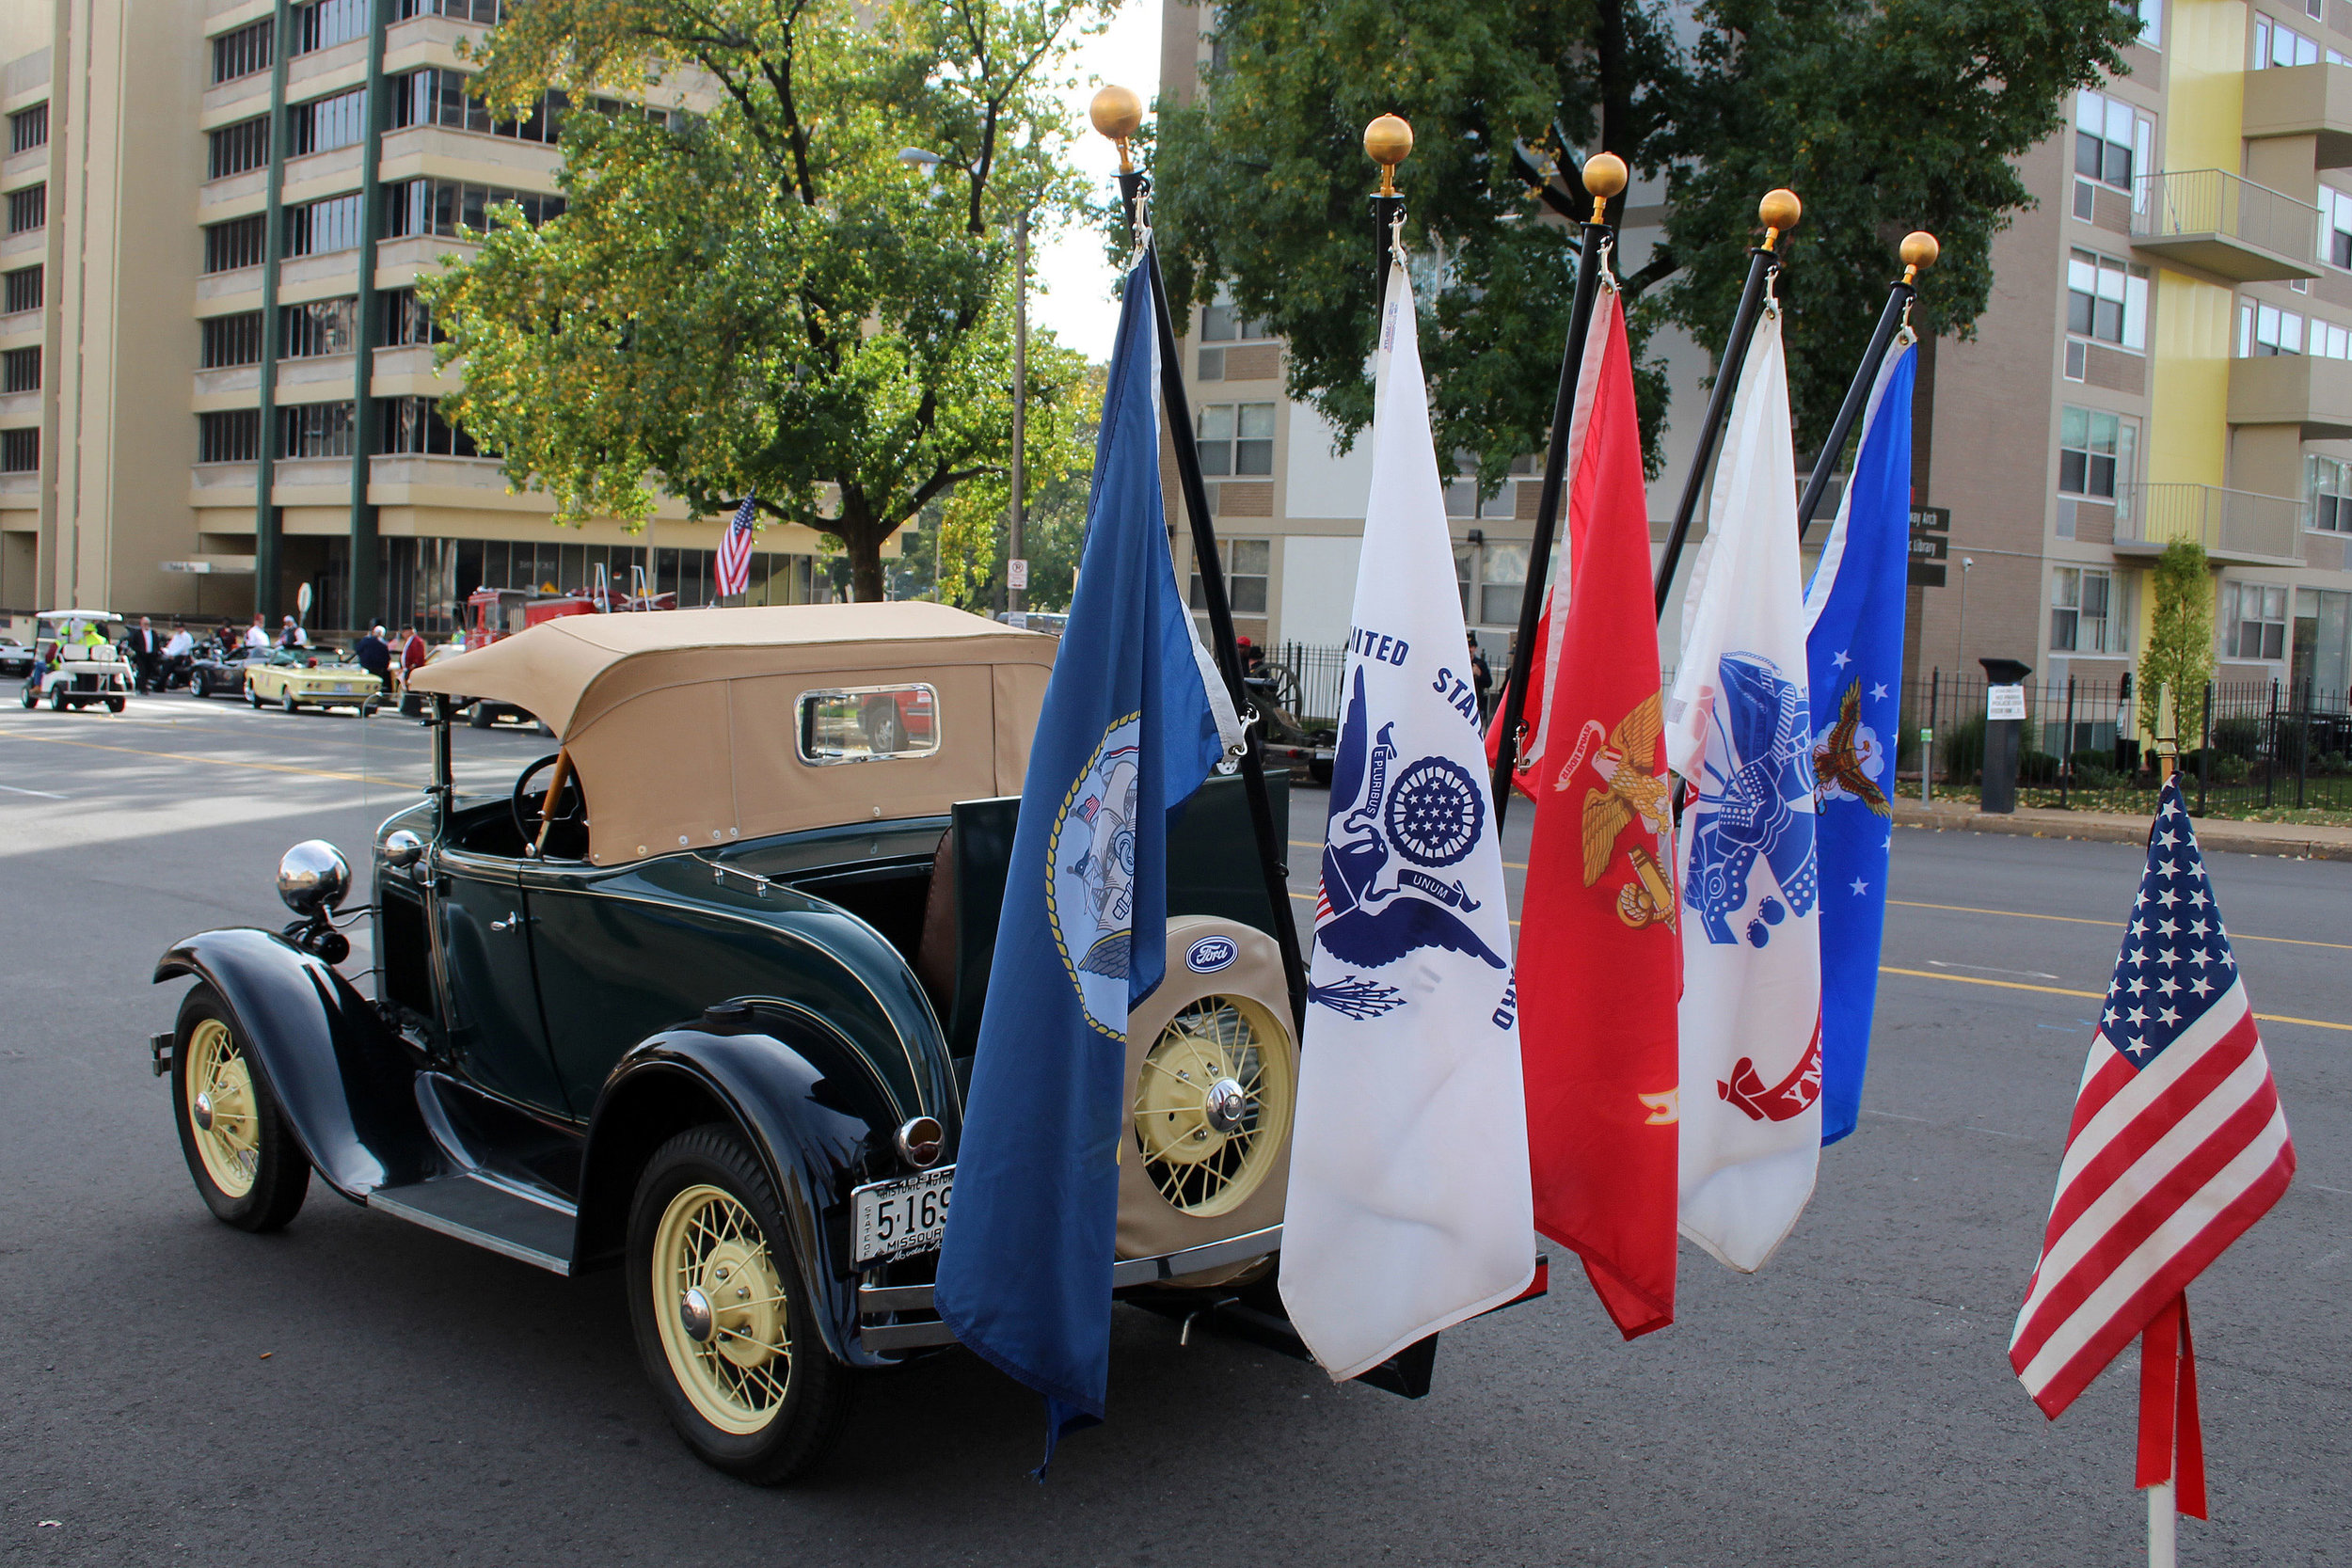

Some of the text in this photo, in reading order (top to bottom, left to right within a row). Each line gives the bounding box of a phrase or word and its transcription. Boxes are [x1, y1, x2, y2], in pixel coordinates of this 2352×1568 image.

[1922, 512, 1937, 526] Arch
[1913, 539, 1936, 557] Library
[1366, 760, 1384, 815] PLURIBUS
[1413, 874, 1449, 899] UNUM
[1196, 944, 1229, 965] Ford
[885, 1243, 927, 1264] Model
